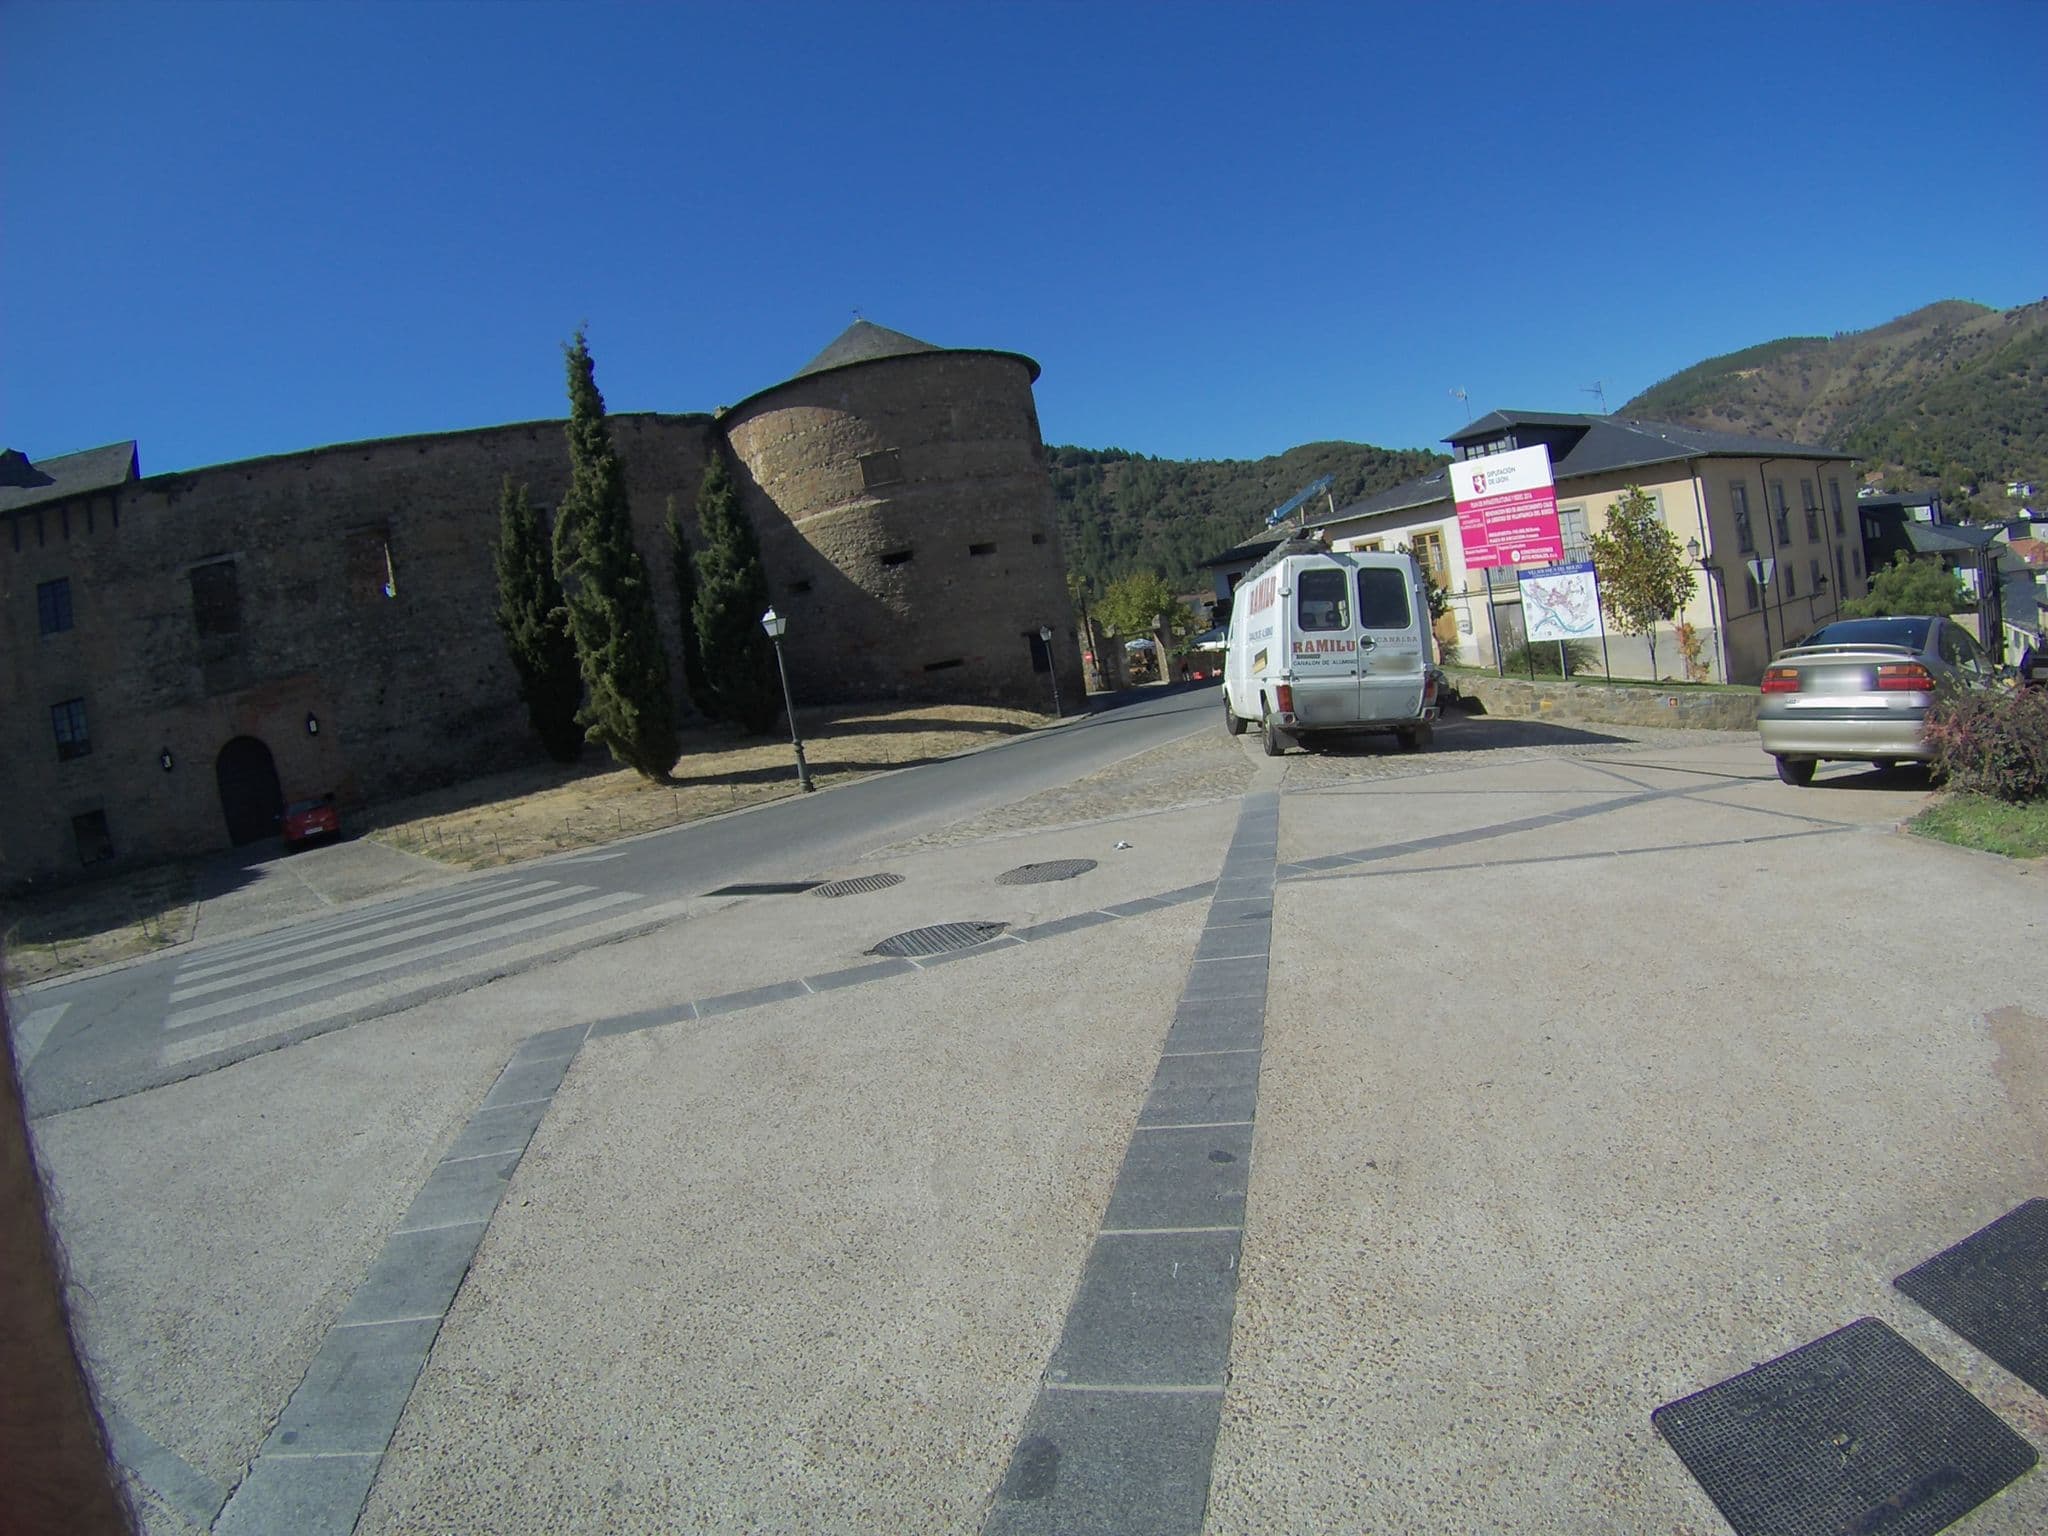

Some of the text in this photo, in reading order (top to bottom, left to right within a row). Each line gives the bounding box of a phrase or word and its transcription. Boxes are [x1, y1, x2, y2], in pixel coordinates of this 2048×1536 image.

[1487, 466, 1516, 477] DIPUTACIÓN
[1488, 477, 1497, 485] DE
[1293, 639, 1356, 653] RAMILU
